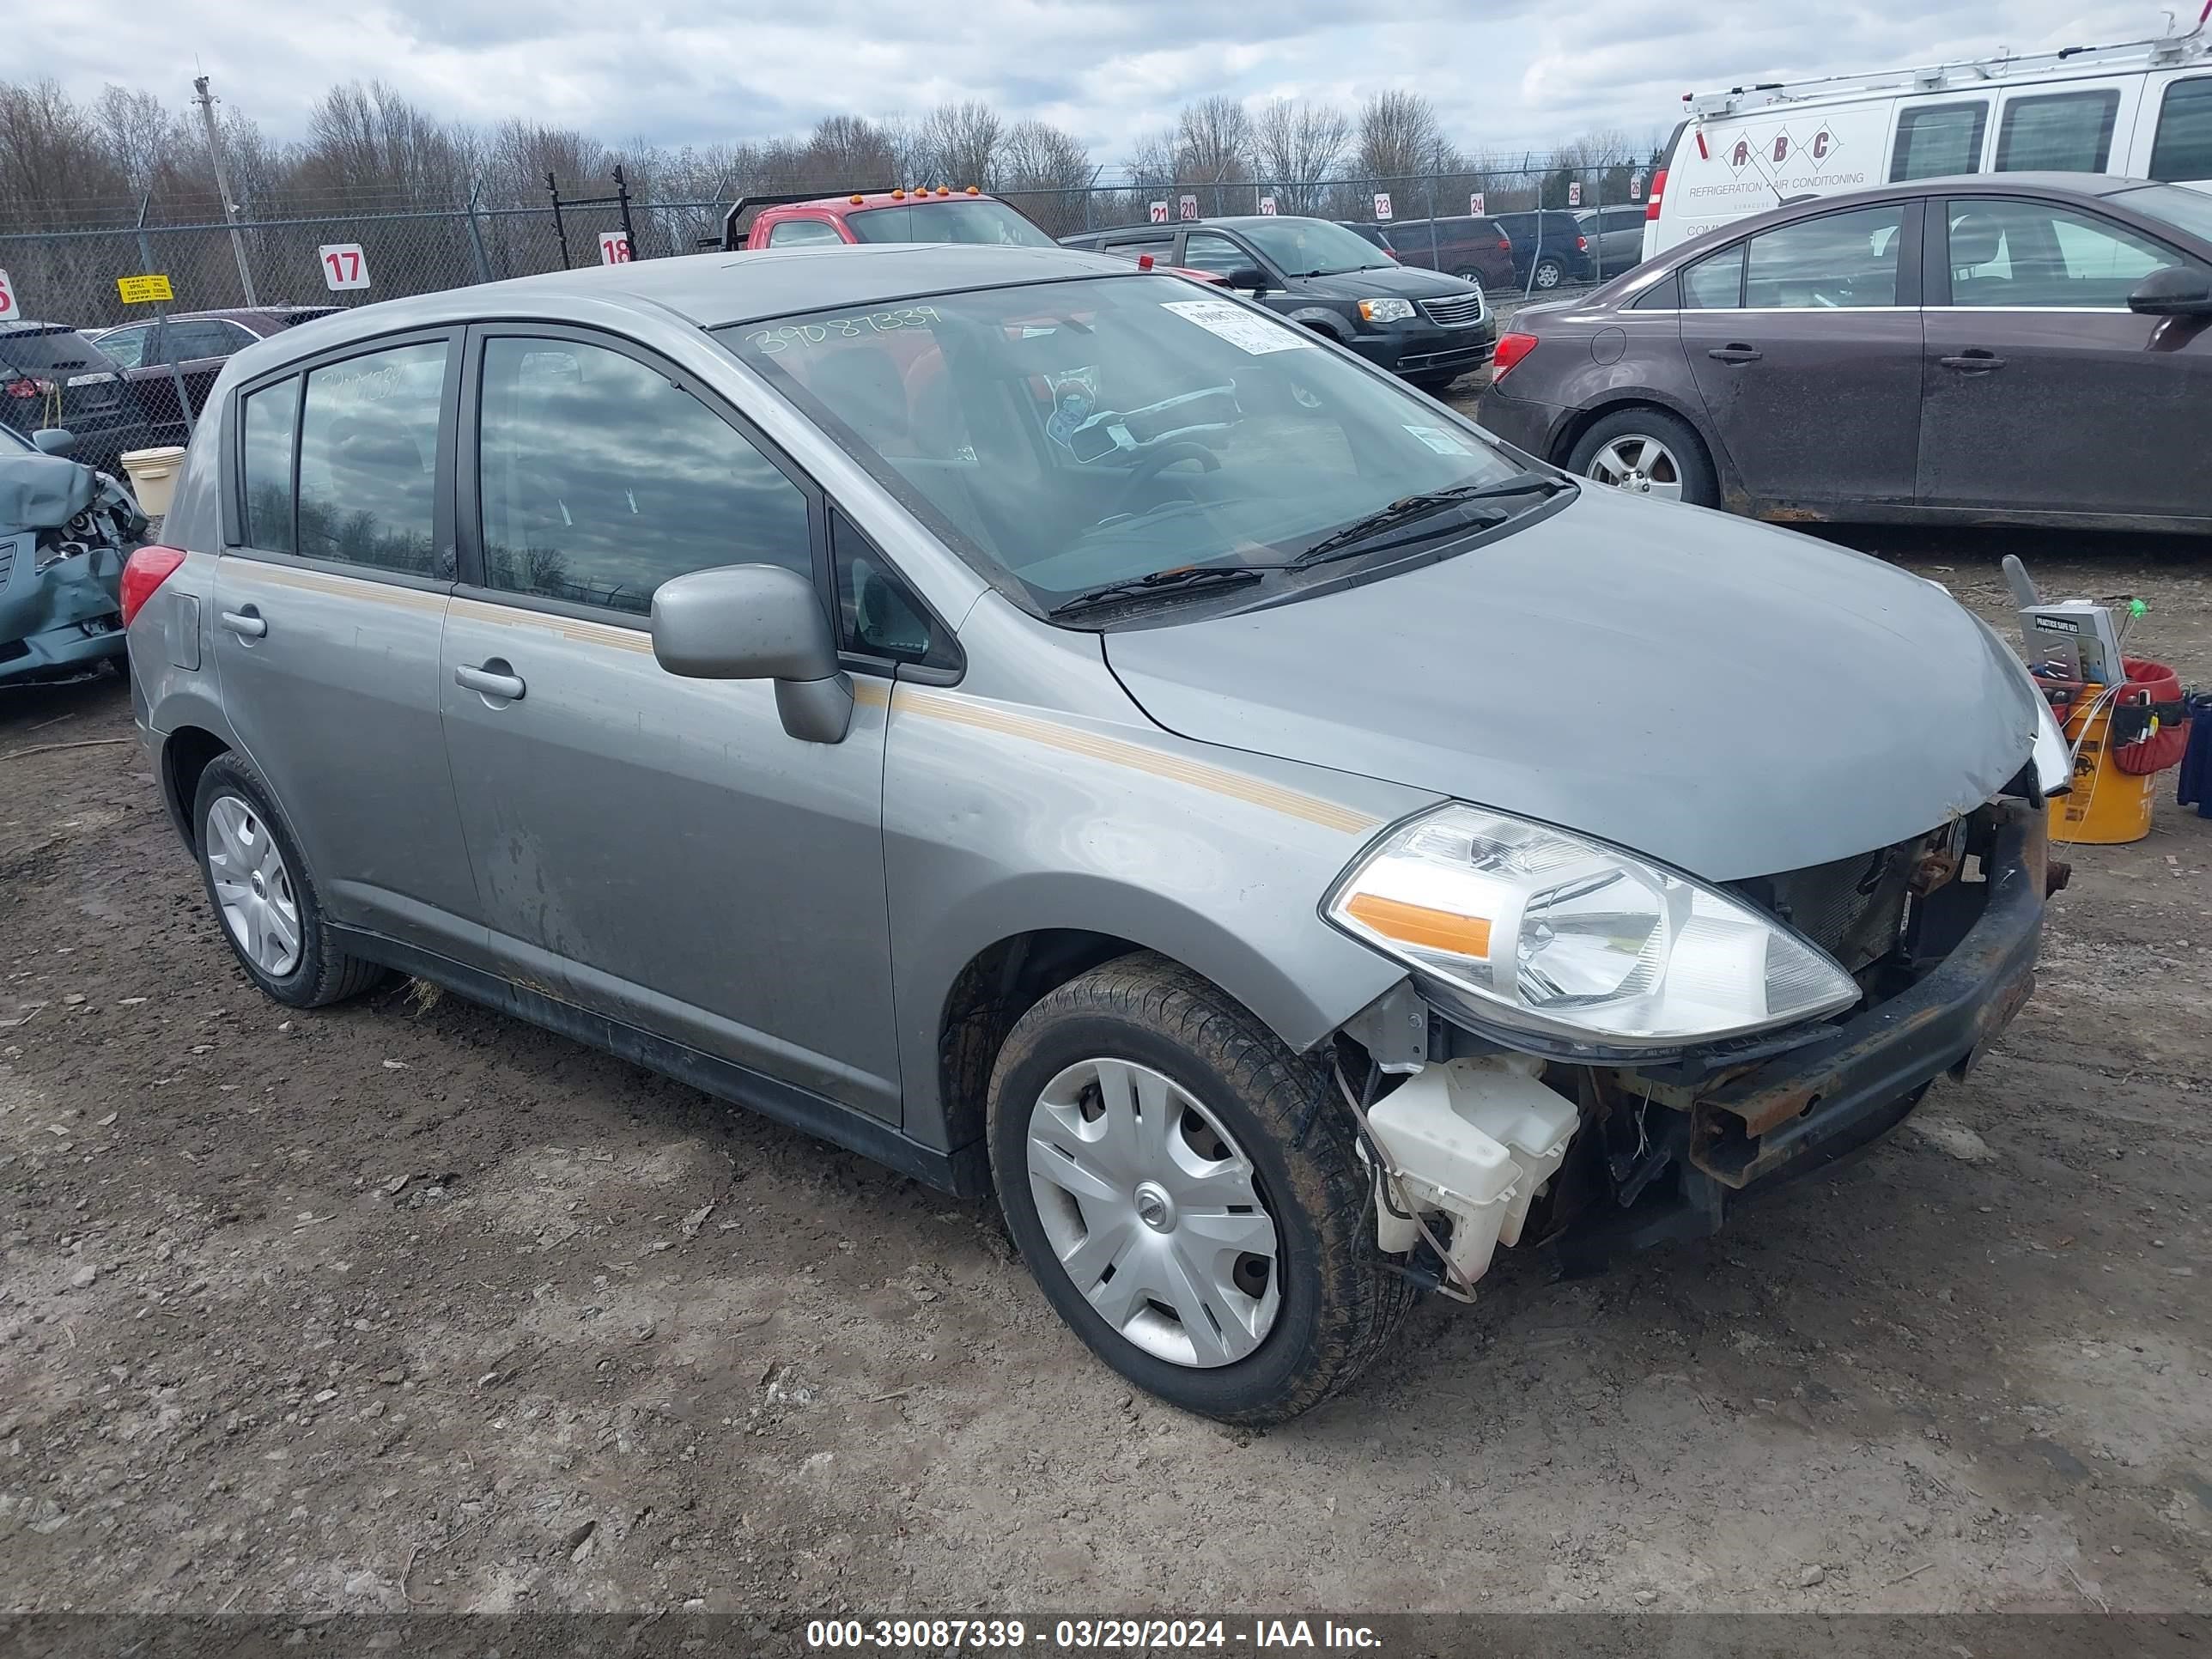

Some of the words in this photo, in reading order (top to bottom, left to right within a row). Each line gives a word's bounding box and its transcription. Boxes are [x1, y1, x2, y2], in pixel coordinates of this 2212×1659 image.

[1732, 140, 1747, 167] A
[1772, 137, 1788, 162] B
[1813, 131, 1829, 159] C
[1570, 186, 1579, 201] 25
[1632, 181, 1640, 195] 26
[1689, 181, 1763, 198] REFRIGERATION
[1772, 178, 1790, 191] AIR
[1792, 172, 1864, 188] CONDITIONING
[1152, 207, 1168, 222] 21
[1182, 202, 1196, 219] 20
[1376, 198, 1390, 214] 23
[1472, 198, 1483, 214] 24
[603, 239, 632, 264] 18
[326, 252, 360, 283] 17
[745, 306, 942, 354] 39087339
